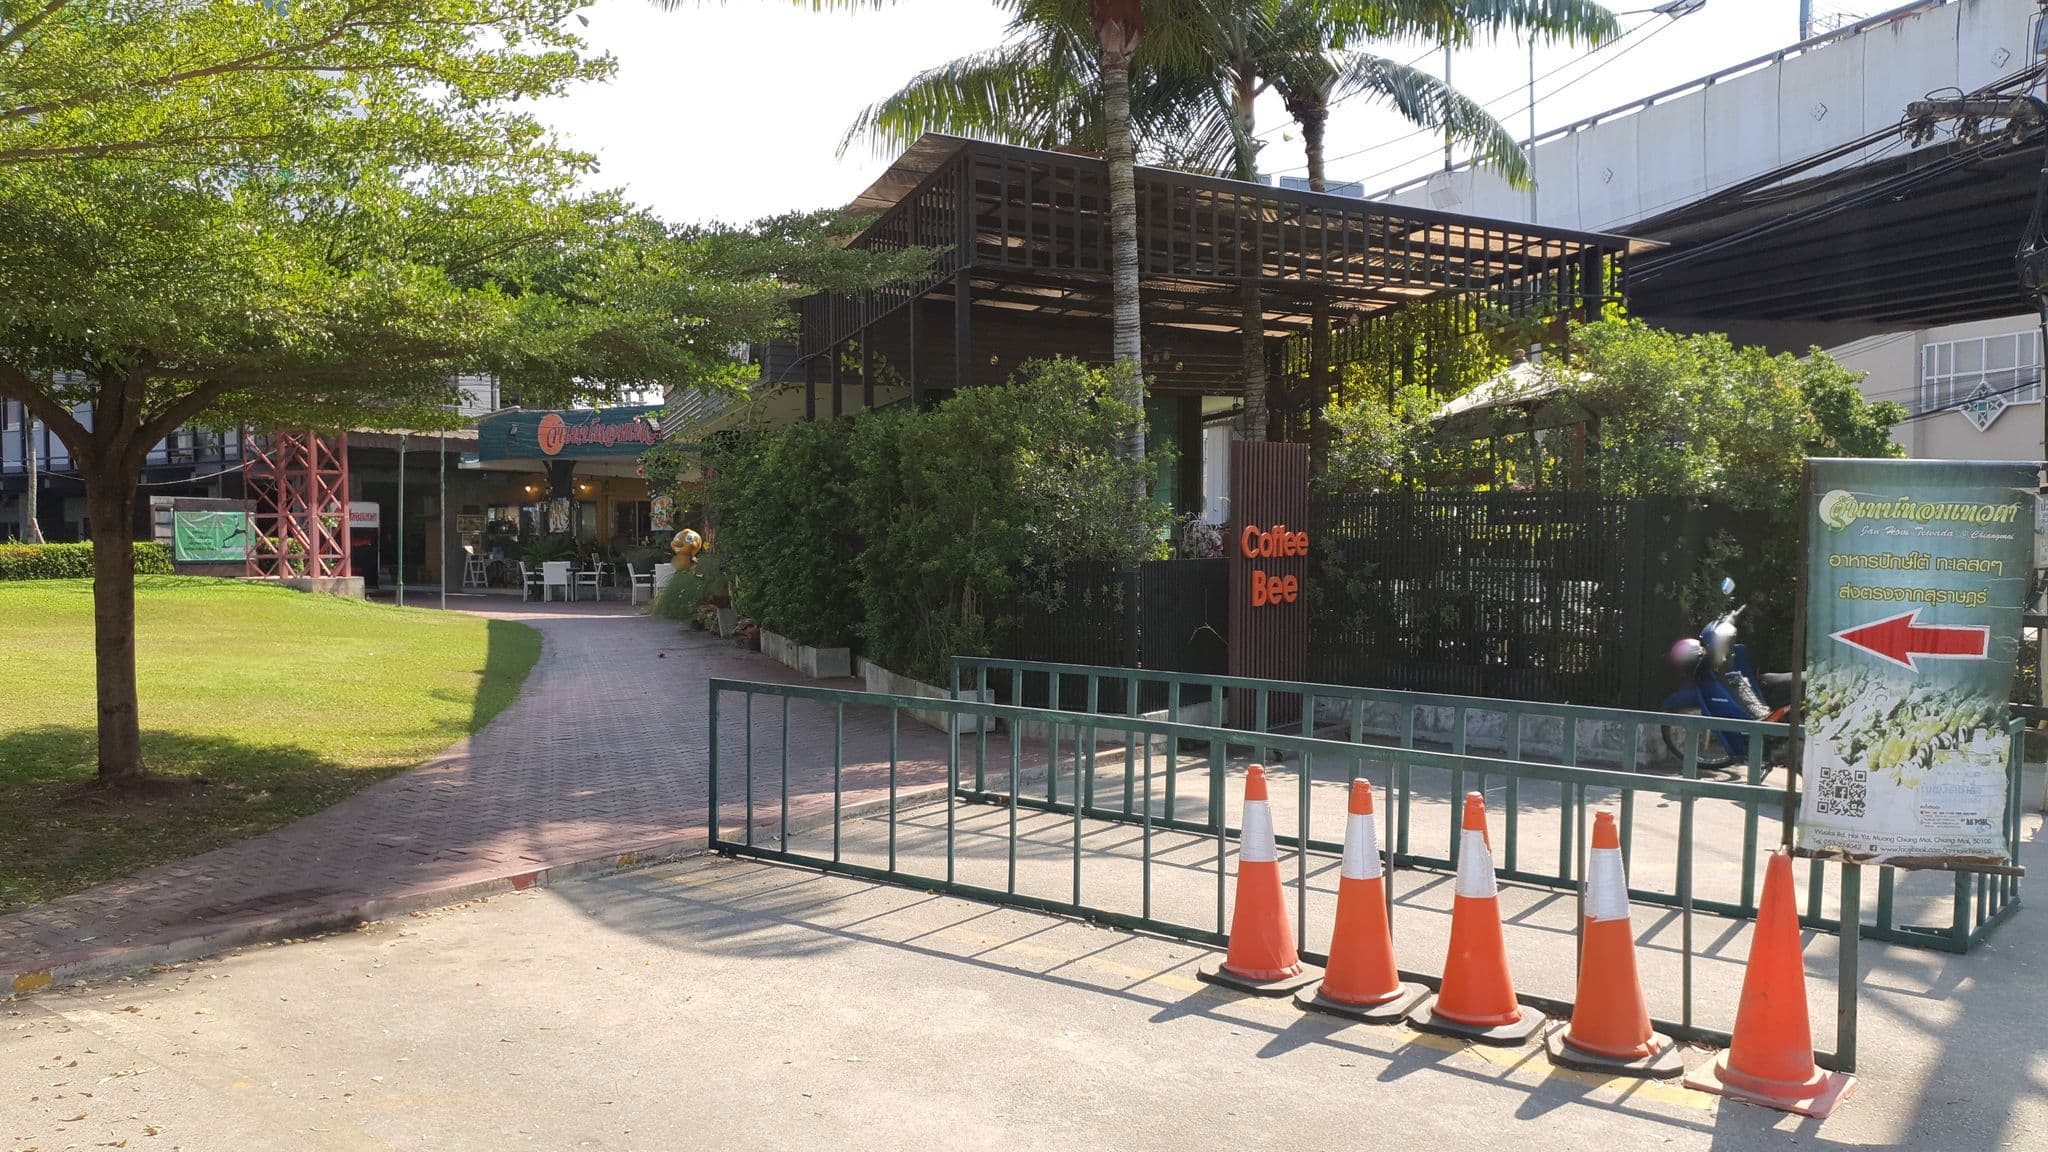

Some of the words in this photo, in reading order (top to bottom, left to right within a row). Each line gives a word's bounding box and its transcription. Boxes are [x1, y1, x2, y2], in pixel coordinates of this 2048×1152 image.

[1241, 524, 1310, 559] Coffee
[1858, 526, 1880, 537] Jan
[1911, 527, 1954, 537] Tewada
[1970, 531, 2015, 541] Chiangmai
[1829, 552, 1932, 570] อาหารปักษ์ใต้
[1936, 557, 2003, 576] ทะเลสดๆ
[1251, 570, 1298, 607] Bee
[1872, 834, 1895, 844] Muang
[1896, 835, 1918, 844] Chiang
[1934, 836, 1955, 845] Chiang
[1973, 837, 1992, 846] 50100
